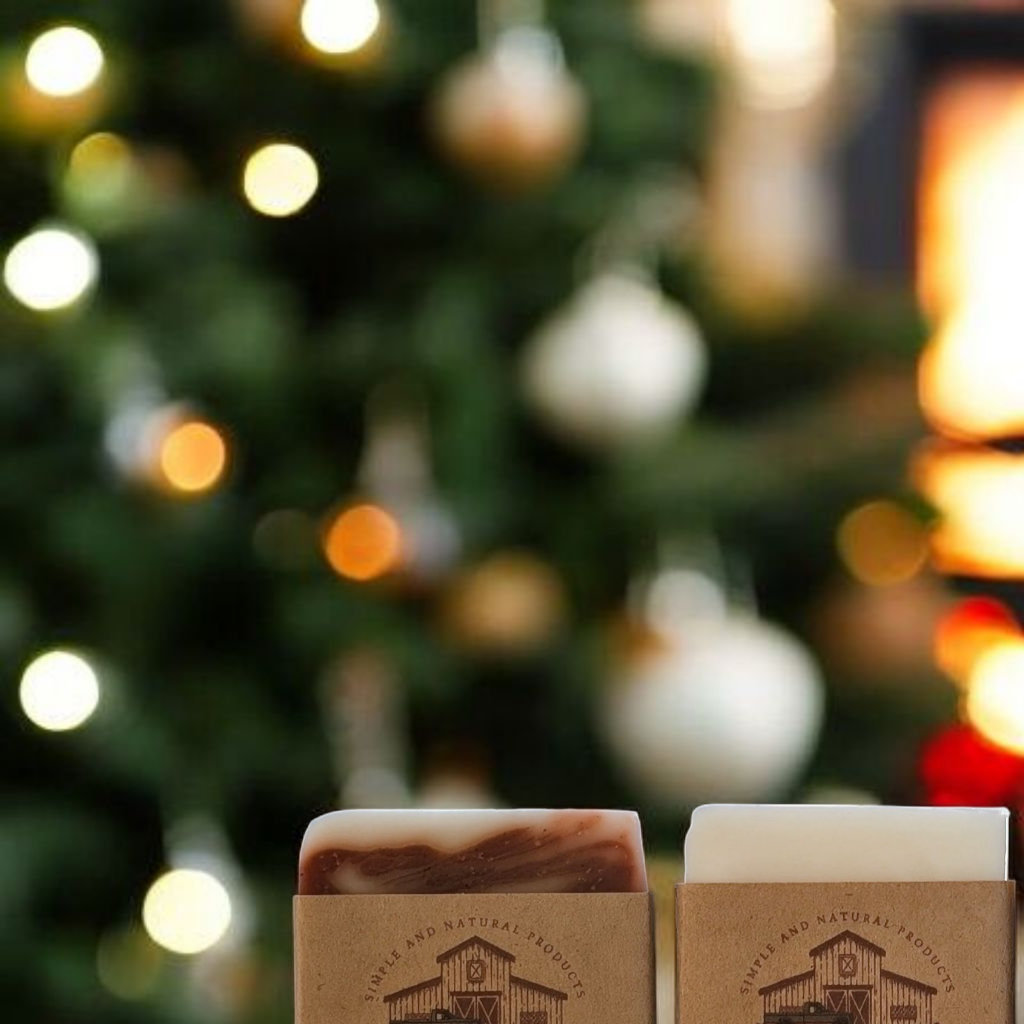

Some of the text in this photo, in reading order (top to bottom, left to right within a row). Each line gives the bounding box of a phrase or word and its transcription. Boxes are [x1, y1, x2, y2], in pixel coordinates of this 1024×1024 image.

[364, 917, 586, 1002] SIMPLE AND NATURAL PRODUCTS
[740, 911, 955, 995] SIMPLE AND NATURAL PRODUCTS
